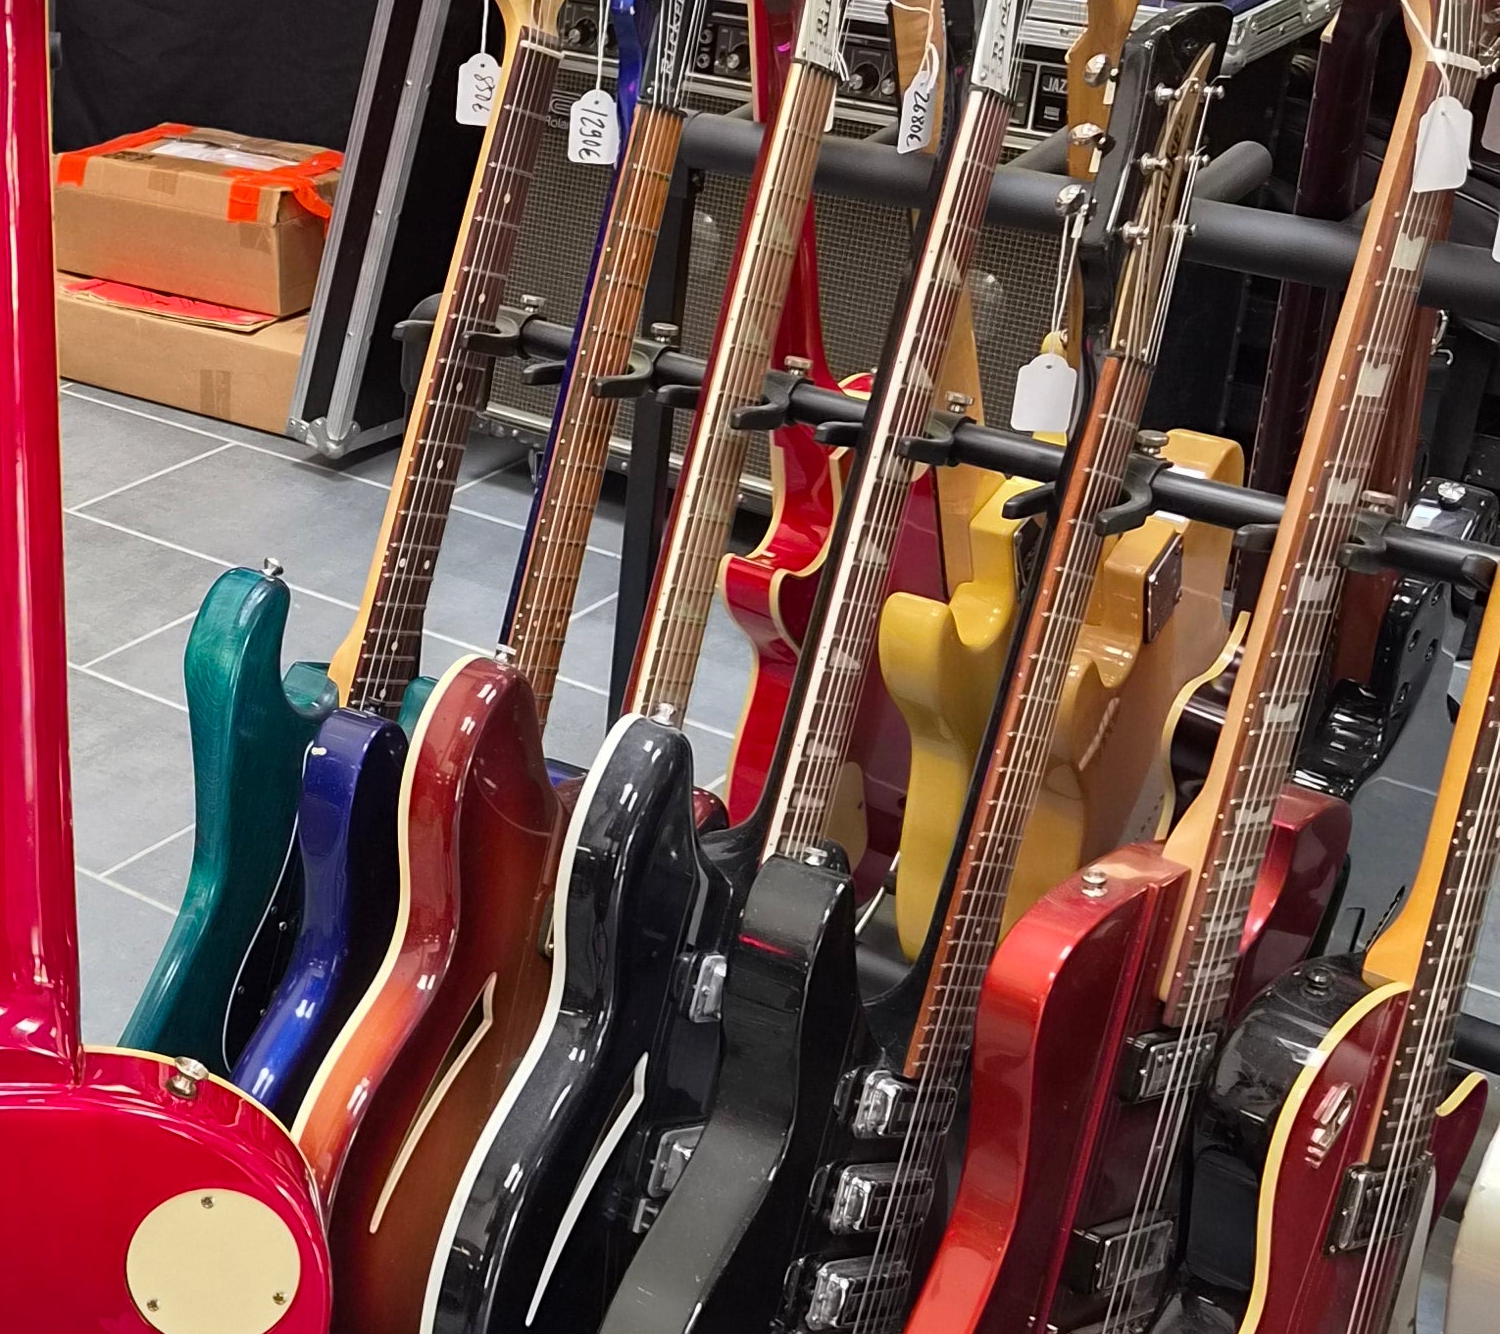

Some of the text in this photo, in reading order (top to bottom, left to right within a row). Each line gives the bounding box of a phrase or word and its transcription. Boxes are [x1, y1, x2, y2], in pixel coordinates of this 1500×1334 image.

[1042, 75, 1068, 95] JAZ
[546, 115, 569, 130] Rola
[578, 108, 609, 160] 1290€
[906, 91, 931, 147] 2680€
